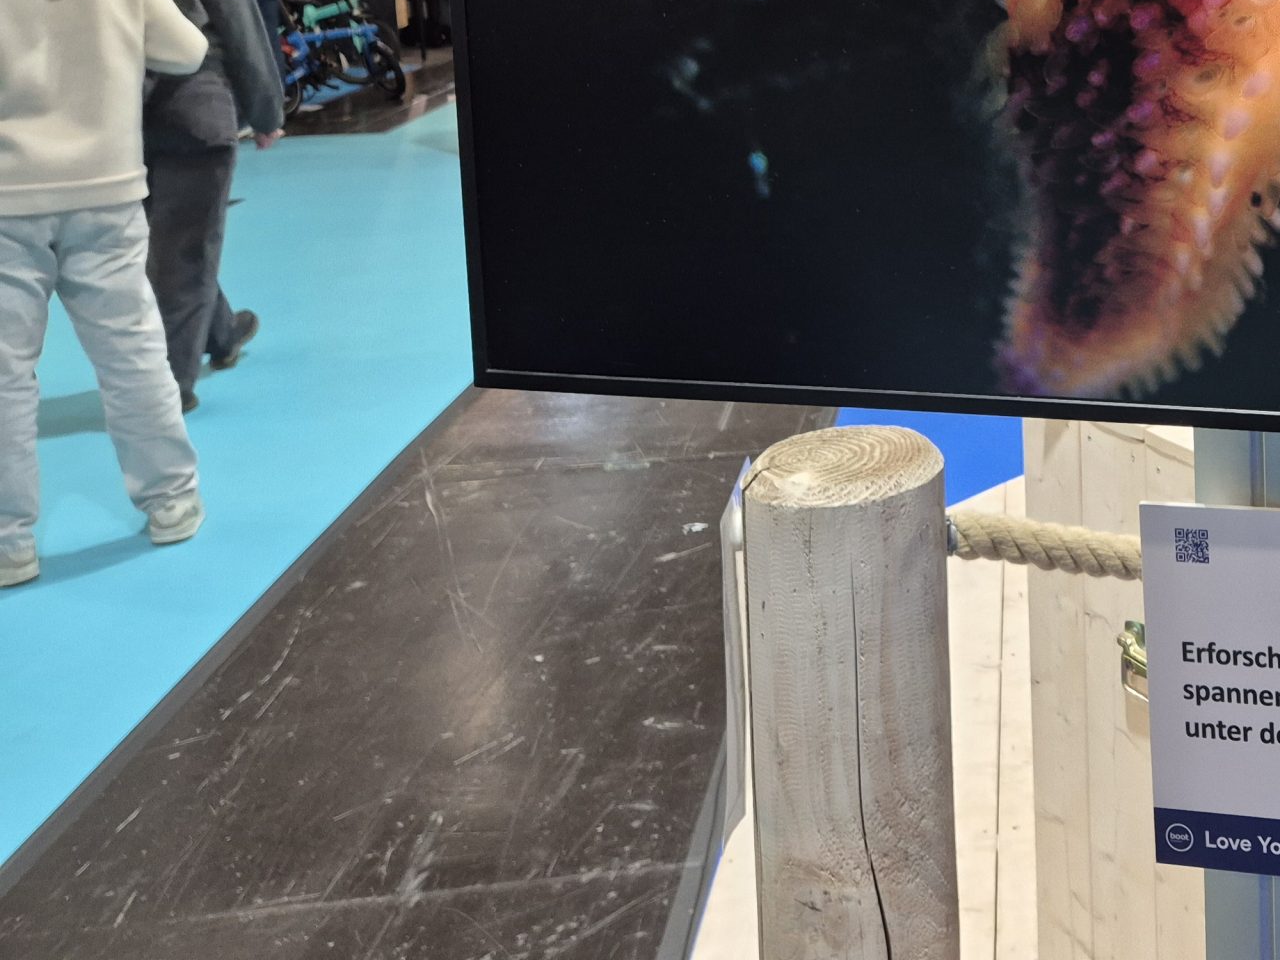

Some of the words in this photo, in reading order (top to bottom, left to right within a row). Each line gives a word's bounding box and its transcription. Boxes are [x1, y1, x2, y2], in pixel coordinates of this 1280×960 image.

[1185, 720, 1252, 742] unter
[1169, 832, 1190, 841] boot
[1205, 830, 1252, 852] Love
